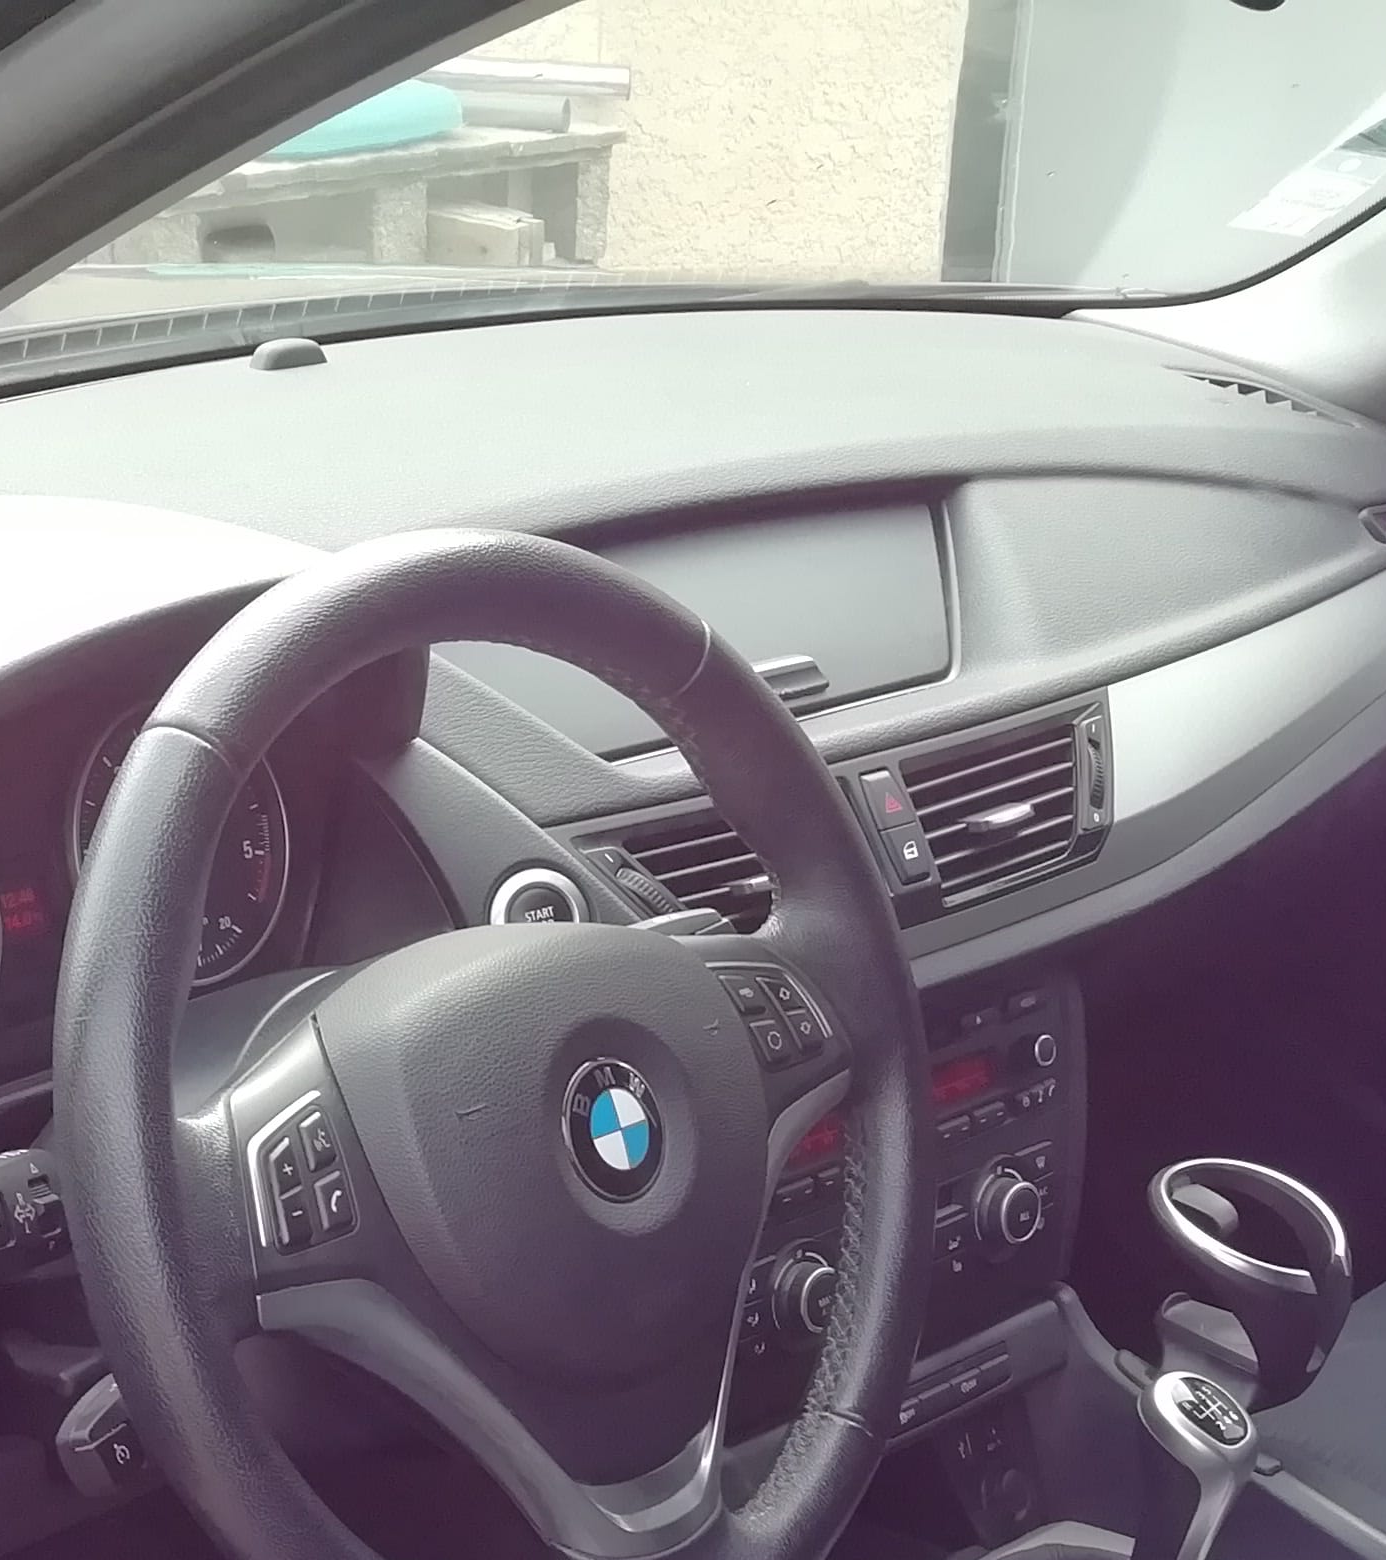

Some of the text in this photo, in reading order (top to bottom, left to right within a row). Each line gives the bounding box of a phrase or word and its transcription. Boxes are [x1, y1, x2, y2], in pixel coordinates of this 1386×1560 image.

[242, 840, 254, 859] 5
[218, 915, 231, 930] 20
[525, 906, 554, 923] START
[572, 1066, 646, 1118] BMW
